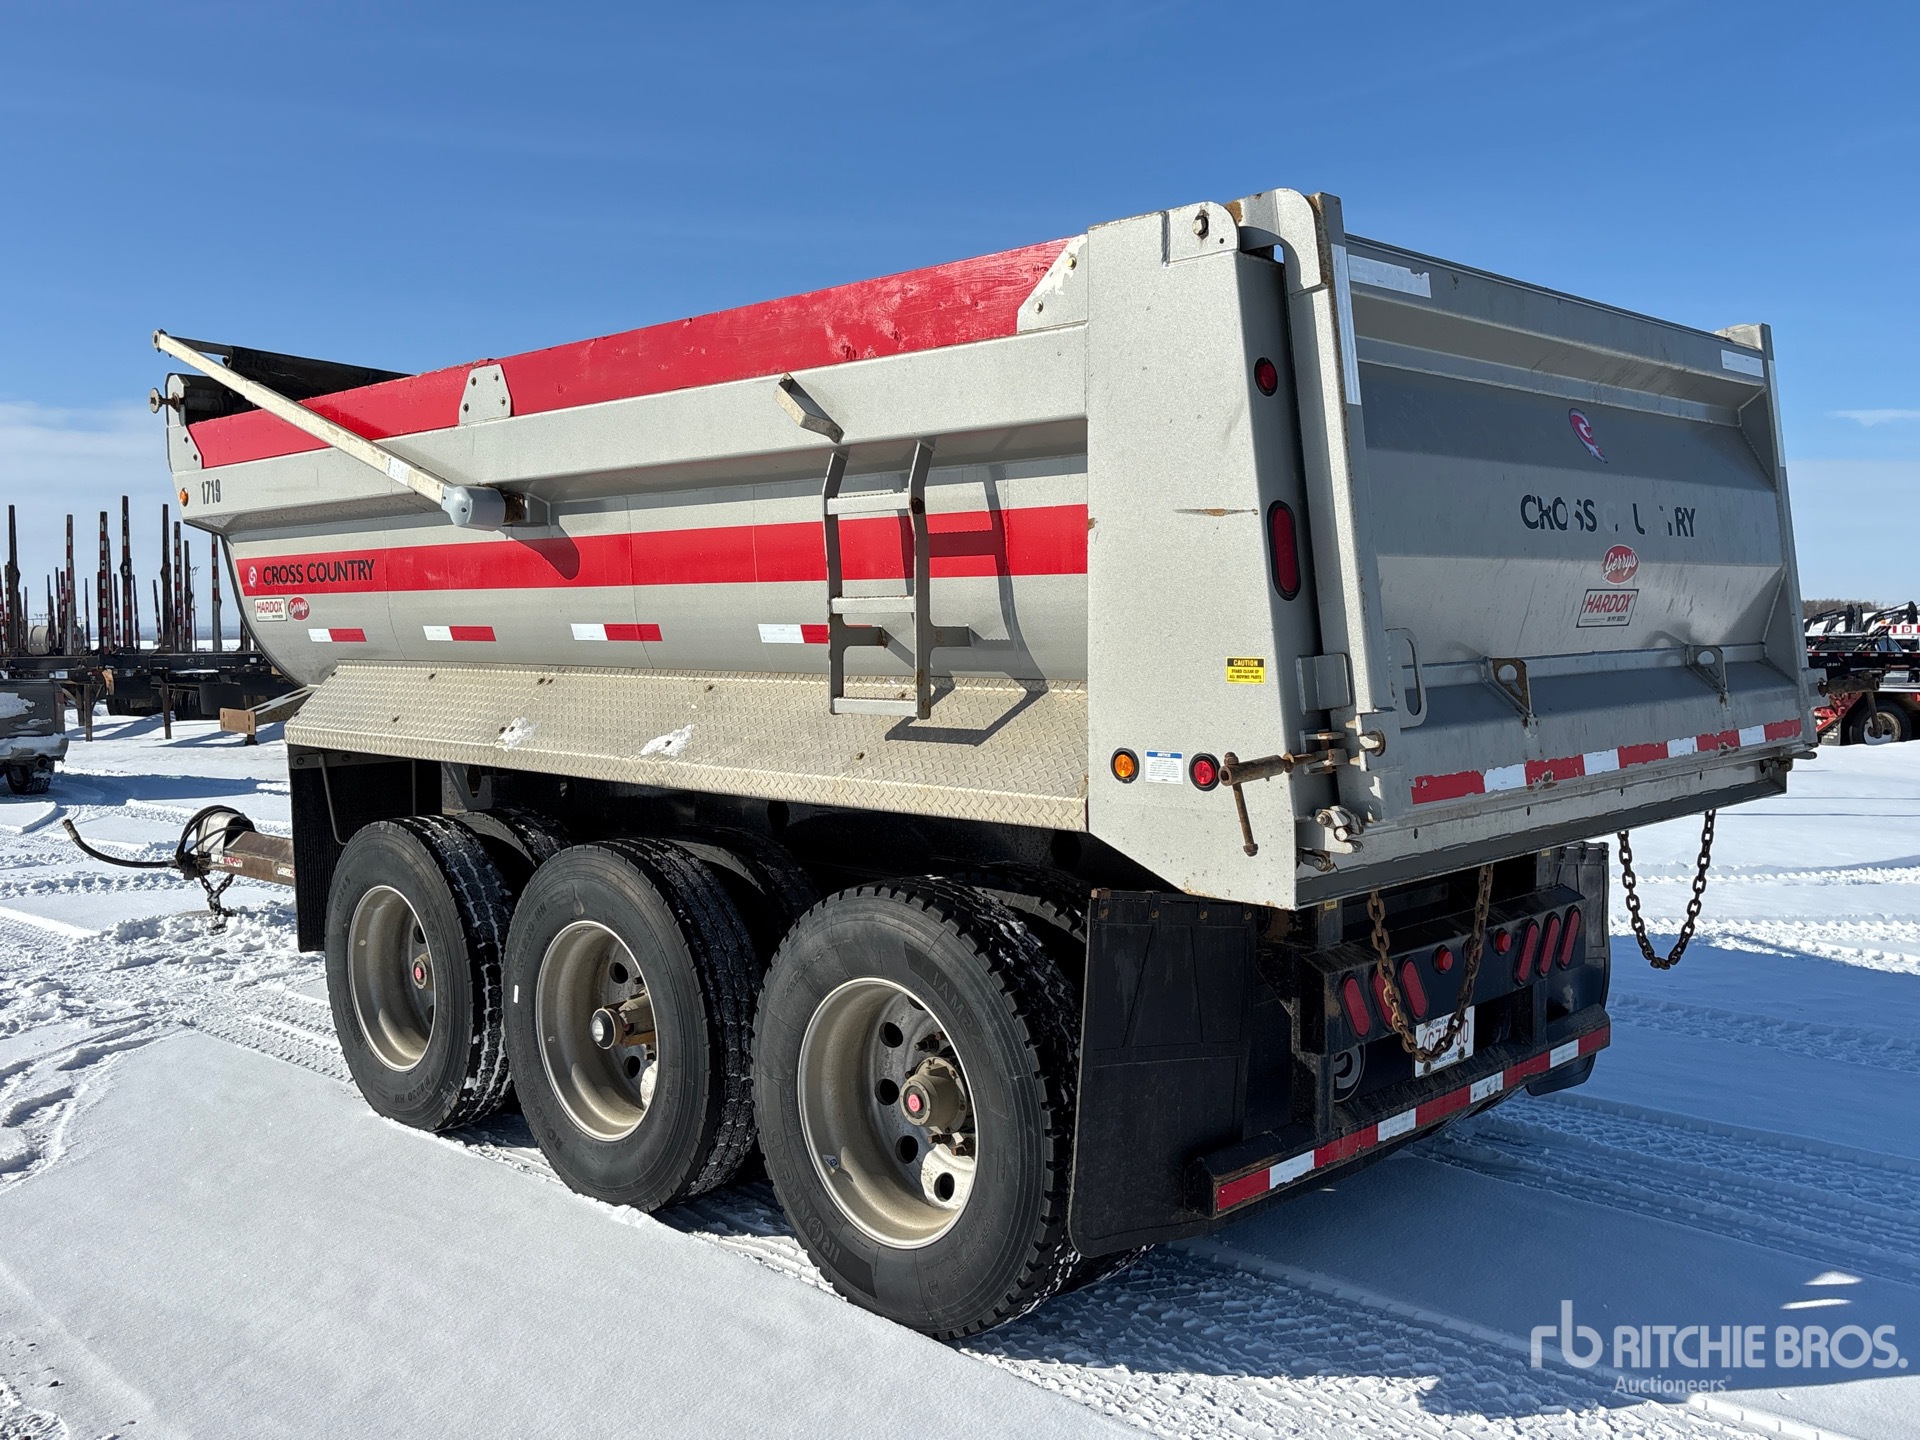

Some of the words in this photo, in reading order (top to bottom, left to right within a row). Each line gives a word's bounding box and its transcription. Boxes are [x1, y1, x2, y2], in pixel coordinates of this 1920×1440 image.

[201, 479, 221, 505] 1719
[263, 564, 304, 586] CROSS
[307, 559, 375, 583] COUNTRY
[256, 601, 283, 613] HARDOX
[1583, 594, 1634, 613] HARDOX
[766, 1127, 841, 1266] IRONHEAD
